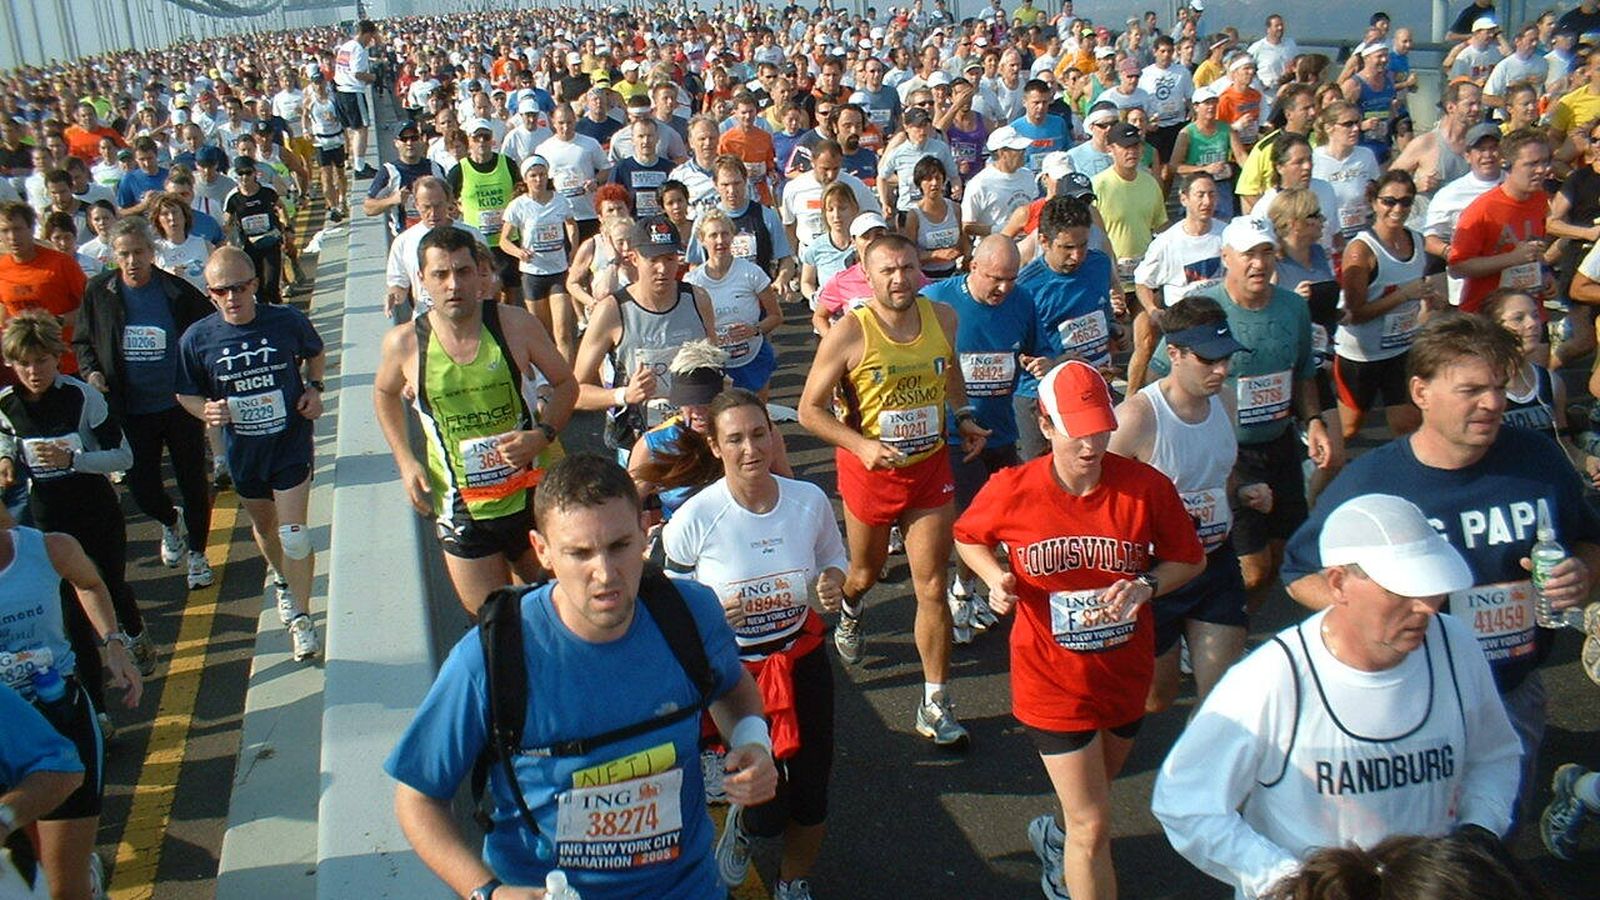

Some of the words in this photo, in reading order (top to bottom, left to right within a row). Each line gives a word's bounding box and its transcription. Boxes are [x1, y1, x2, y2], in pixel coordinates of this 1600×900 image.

[1067, 318, 1086, 330] ING
[970, 357, 992, 365] ING
[234, 374, 275, 392] RICH
[897, 375, 922, 391] GO!
[237, 400, 258, 409] ING
[240, 405, 274, 421] 22329
[889, 412, 914, 423] ING
[893, 421, 927, 438] 40241
[473, 438, 500, 453] ING
[1183, 495, 1202, 505] NG
[741, 581, 771, 598] ING
[745, 592, 792, 613] 48943
[1066, 595, 1098, 608] ING
[1469, 591, 1505, 607] ING
[767, 611, 787, 621] YORK
[1068, 610, 1077, 631] F
[1473, 605, 1524, 633] 41459
[1316, 744, 1454, 795] RANDBURG
[583, 789, 631, 809] ING
[586, 802, 659, 838] 38274
[560, 843, 583, 856] ING
[585, 843, 617, 856] NEW
[619, 838, 651, 854] YORK
[653, 832, 681, 849] CITY
[558, 855, 632, 869] MARATHON
